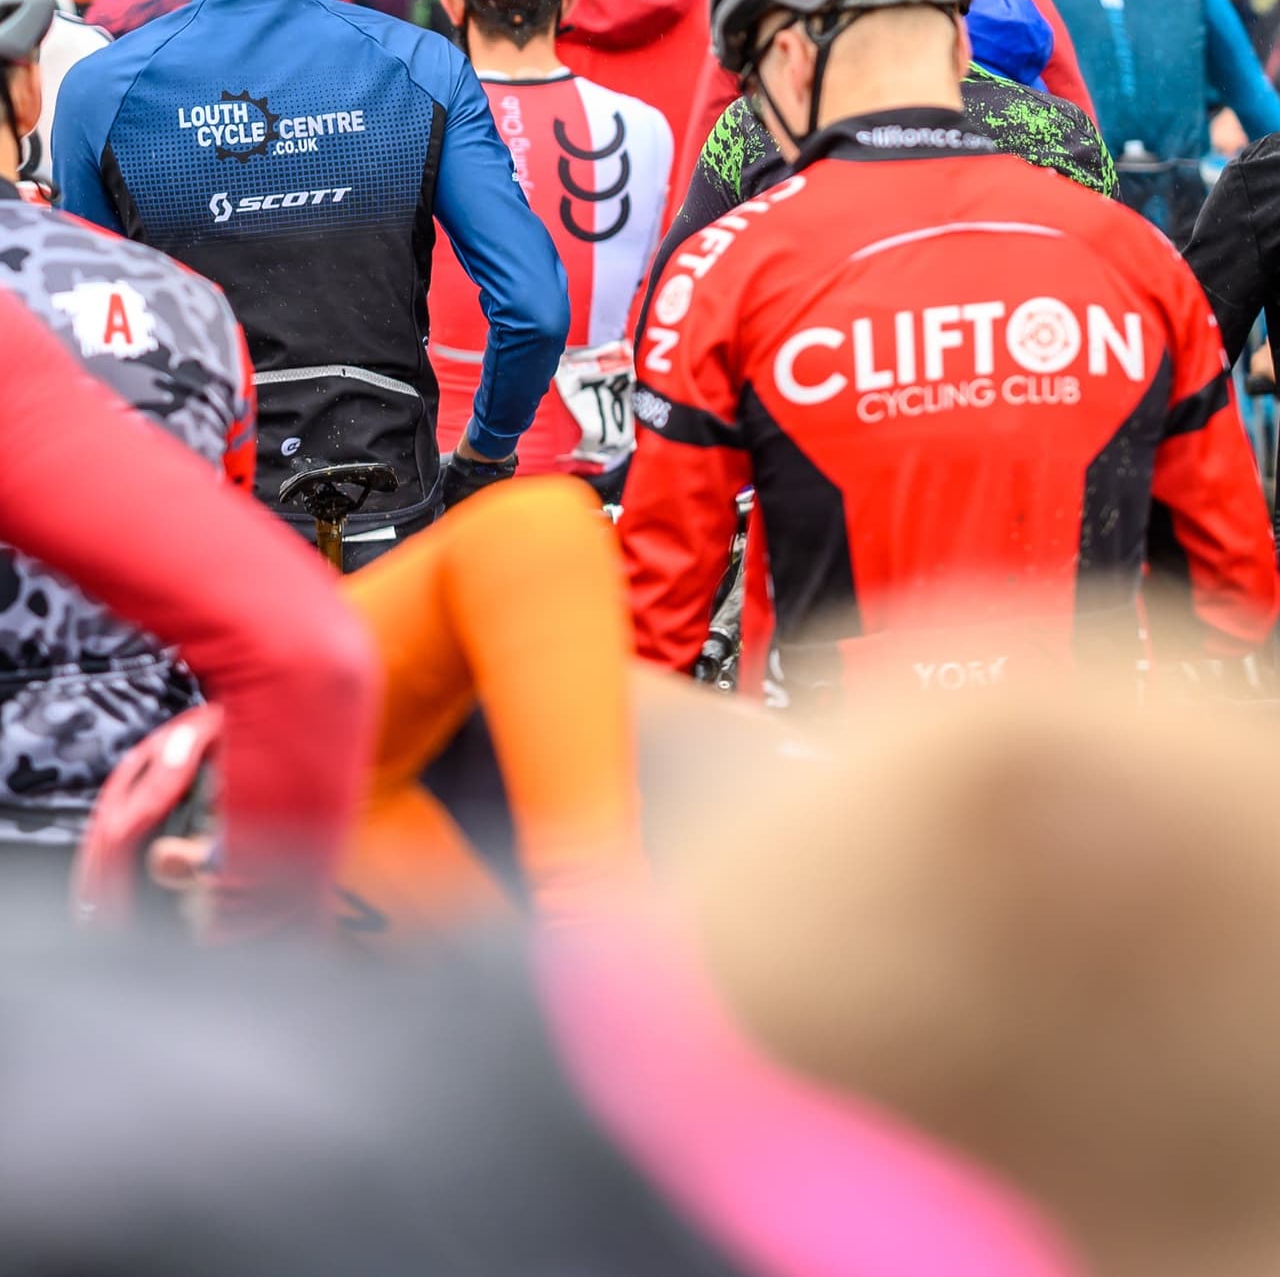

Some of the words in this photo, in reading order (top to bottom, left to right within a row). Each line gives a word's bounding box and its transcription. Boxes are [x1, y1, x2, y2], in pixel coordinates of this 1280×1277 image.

[177, 103, 249, 129] LOUTH
[196, 121, 266, 148] CYCLE
[278, 109, 366, 140] CENTRE
[272, 137, 319, 156] .CO.UK
[236, 186, 353, 213] SCOTT
[103, 293, 133, 344] A
[772, 296, 1145, 405] CLIFTON
[855, 378, 997, 424] CYCLING
[1000, 374, 1082, 406] CLUB
